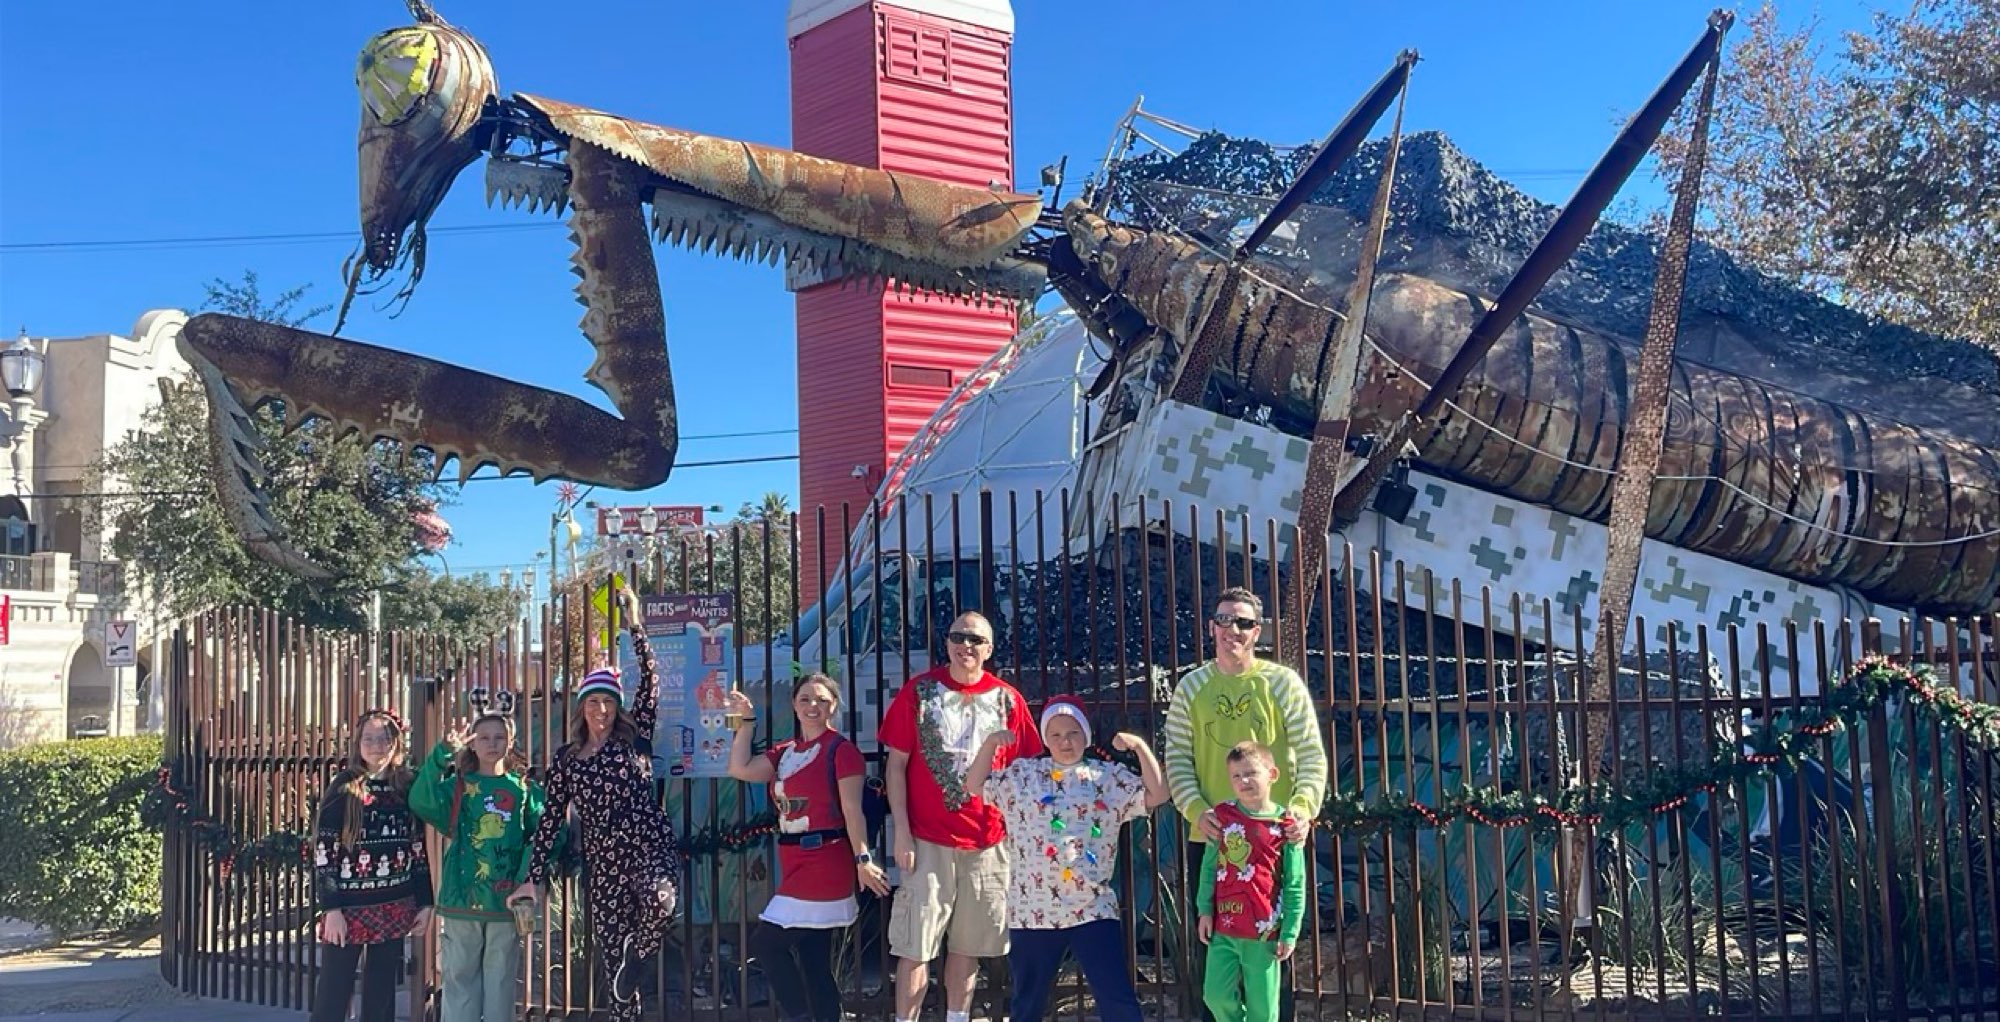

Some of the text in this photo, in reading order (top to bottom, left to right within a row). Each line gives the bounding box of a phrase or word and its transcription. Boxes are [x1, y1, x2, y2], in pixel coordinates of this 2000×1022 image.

[699, 598, 720, 607] THE
[647, 602, 674, 616] FACTS
[691, 607, 728, 617] MANTIS
